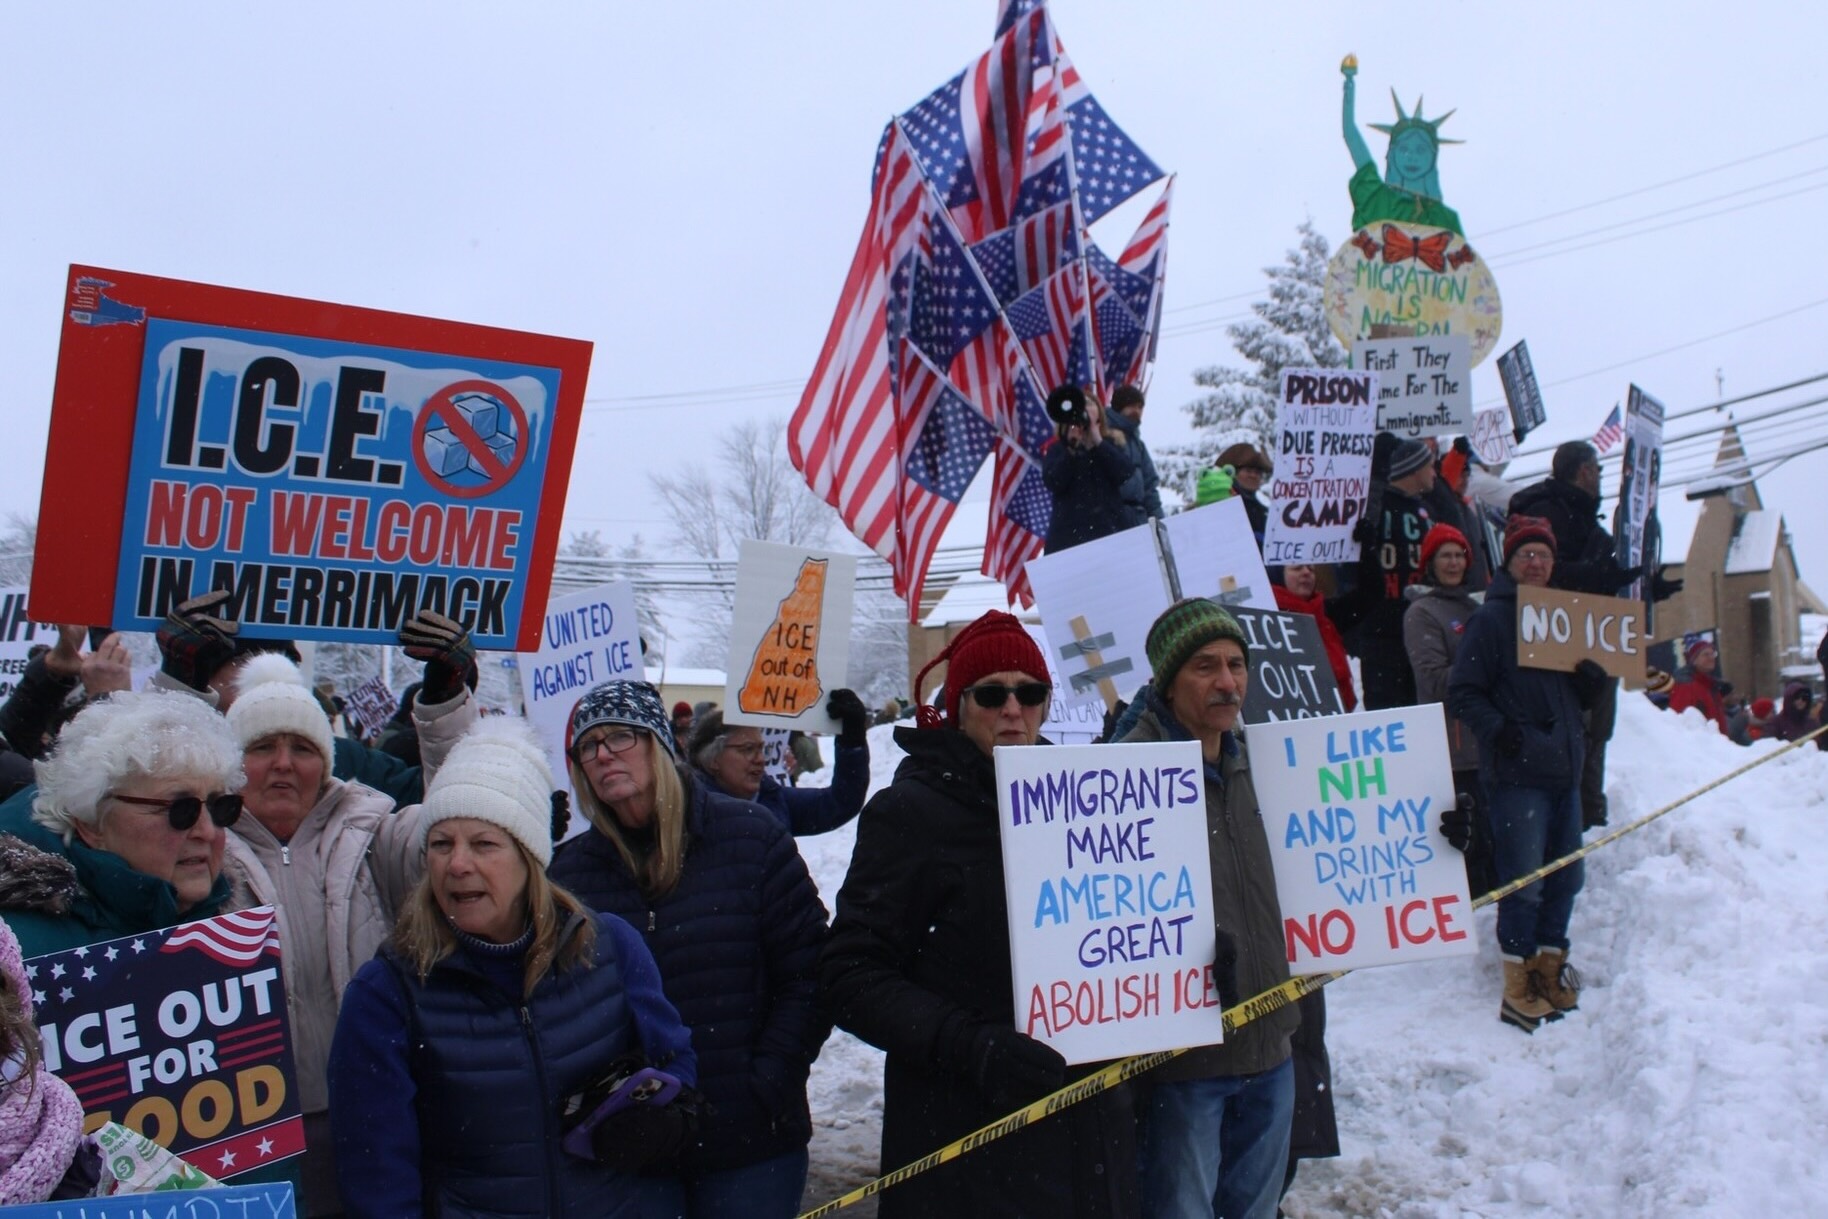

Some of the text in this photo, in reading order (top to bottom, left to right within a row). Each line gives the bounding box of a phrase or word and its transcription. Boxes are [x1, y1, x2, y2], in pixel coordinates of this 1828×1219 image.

[1355, 259, 1467, 304] MIGRATION
[1397, 293, 1421, 319] IS
[1365, 346, 1451, 370] First They
[1286, 375, 1370, 406] PRISON
[1377, 374, 1459, 400] me For The
[165, 347, 405, 485] I.C.E.
[1294, 407, 1354, 426] WITHOUT
[1282, 429, 1373, 457] DUE PROCESS
[1272, 478, 1365, 500] CONCENTRATION
[1293, 457, 1335, 476] IS A
[146, 481, 522, 571] NOT WELCOME
[1384, 511, 1436, 540] IC
[1269, 538, 1346, 562] ICE OUT!
[1381, 543, 1421, 570] OU
[136, 556, 512, 636] IN MERRIMACK
[546, 602, 613, 650] UNITED
[776, 622, 814, 651] ICE
[1237, 614, 1304, 653] ICE
[1522, 603, 1637, 654] NO ICE
[0, 659, 26, 674] REE
[534, 641, 632, 701] AGAINST ICE
[761, 657, 814, 680] out of
[1260, 661, 1321, 706] OUT
[763, 686, 797, 710] NH
[1284, 721, 1407, 767] I LIKE
[1010, 767, 1198, 826] IMMIGRANTS
[1318, 757, 1387, 803] NH
[1067, 818, 1155, 869] MAKE
[1285, 796, 1431, 848] AND MY
[1315, 836, 1434, 883] DRINKS
[1034, 865, 1195, 928] AMERICA
[1334, 869, 1416, 905] WITH
[1078, 914, 1194, 968] GREAT
[1284, 895, 1467, 963] NO ICE
[40, 967, 278, 1073] ICE OUT
[1027, 964, 1220, 1039] ABOLISH ICE
[128, 1039, 219, 1094] FOR
